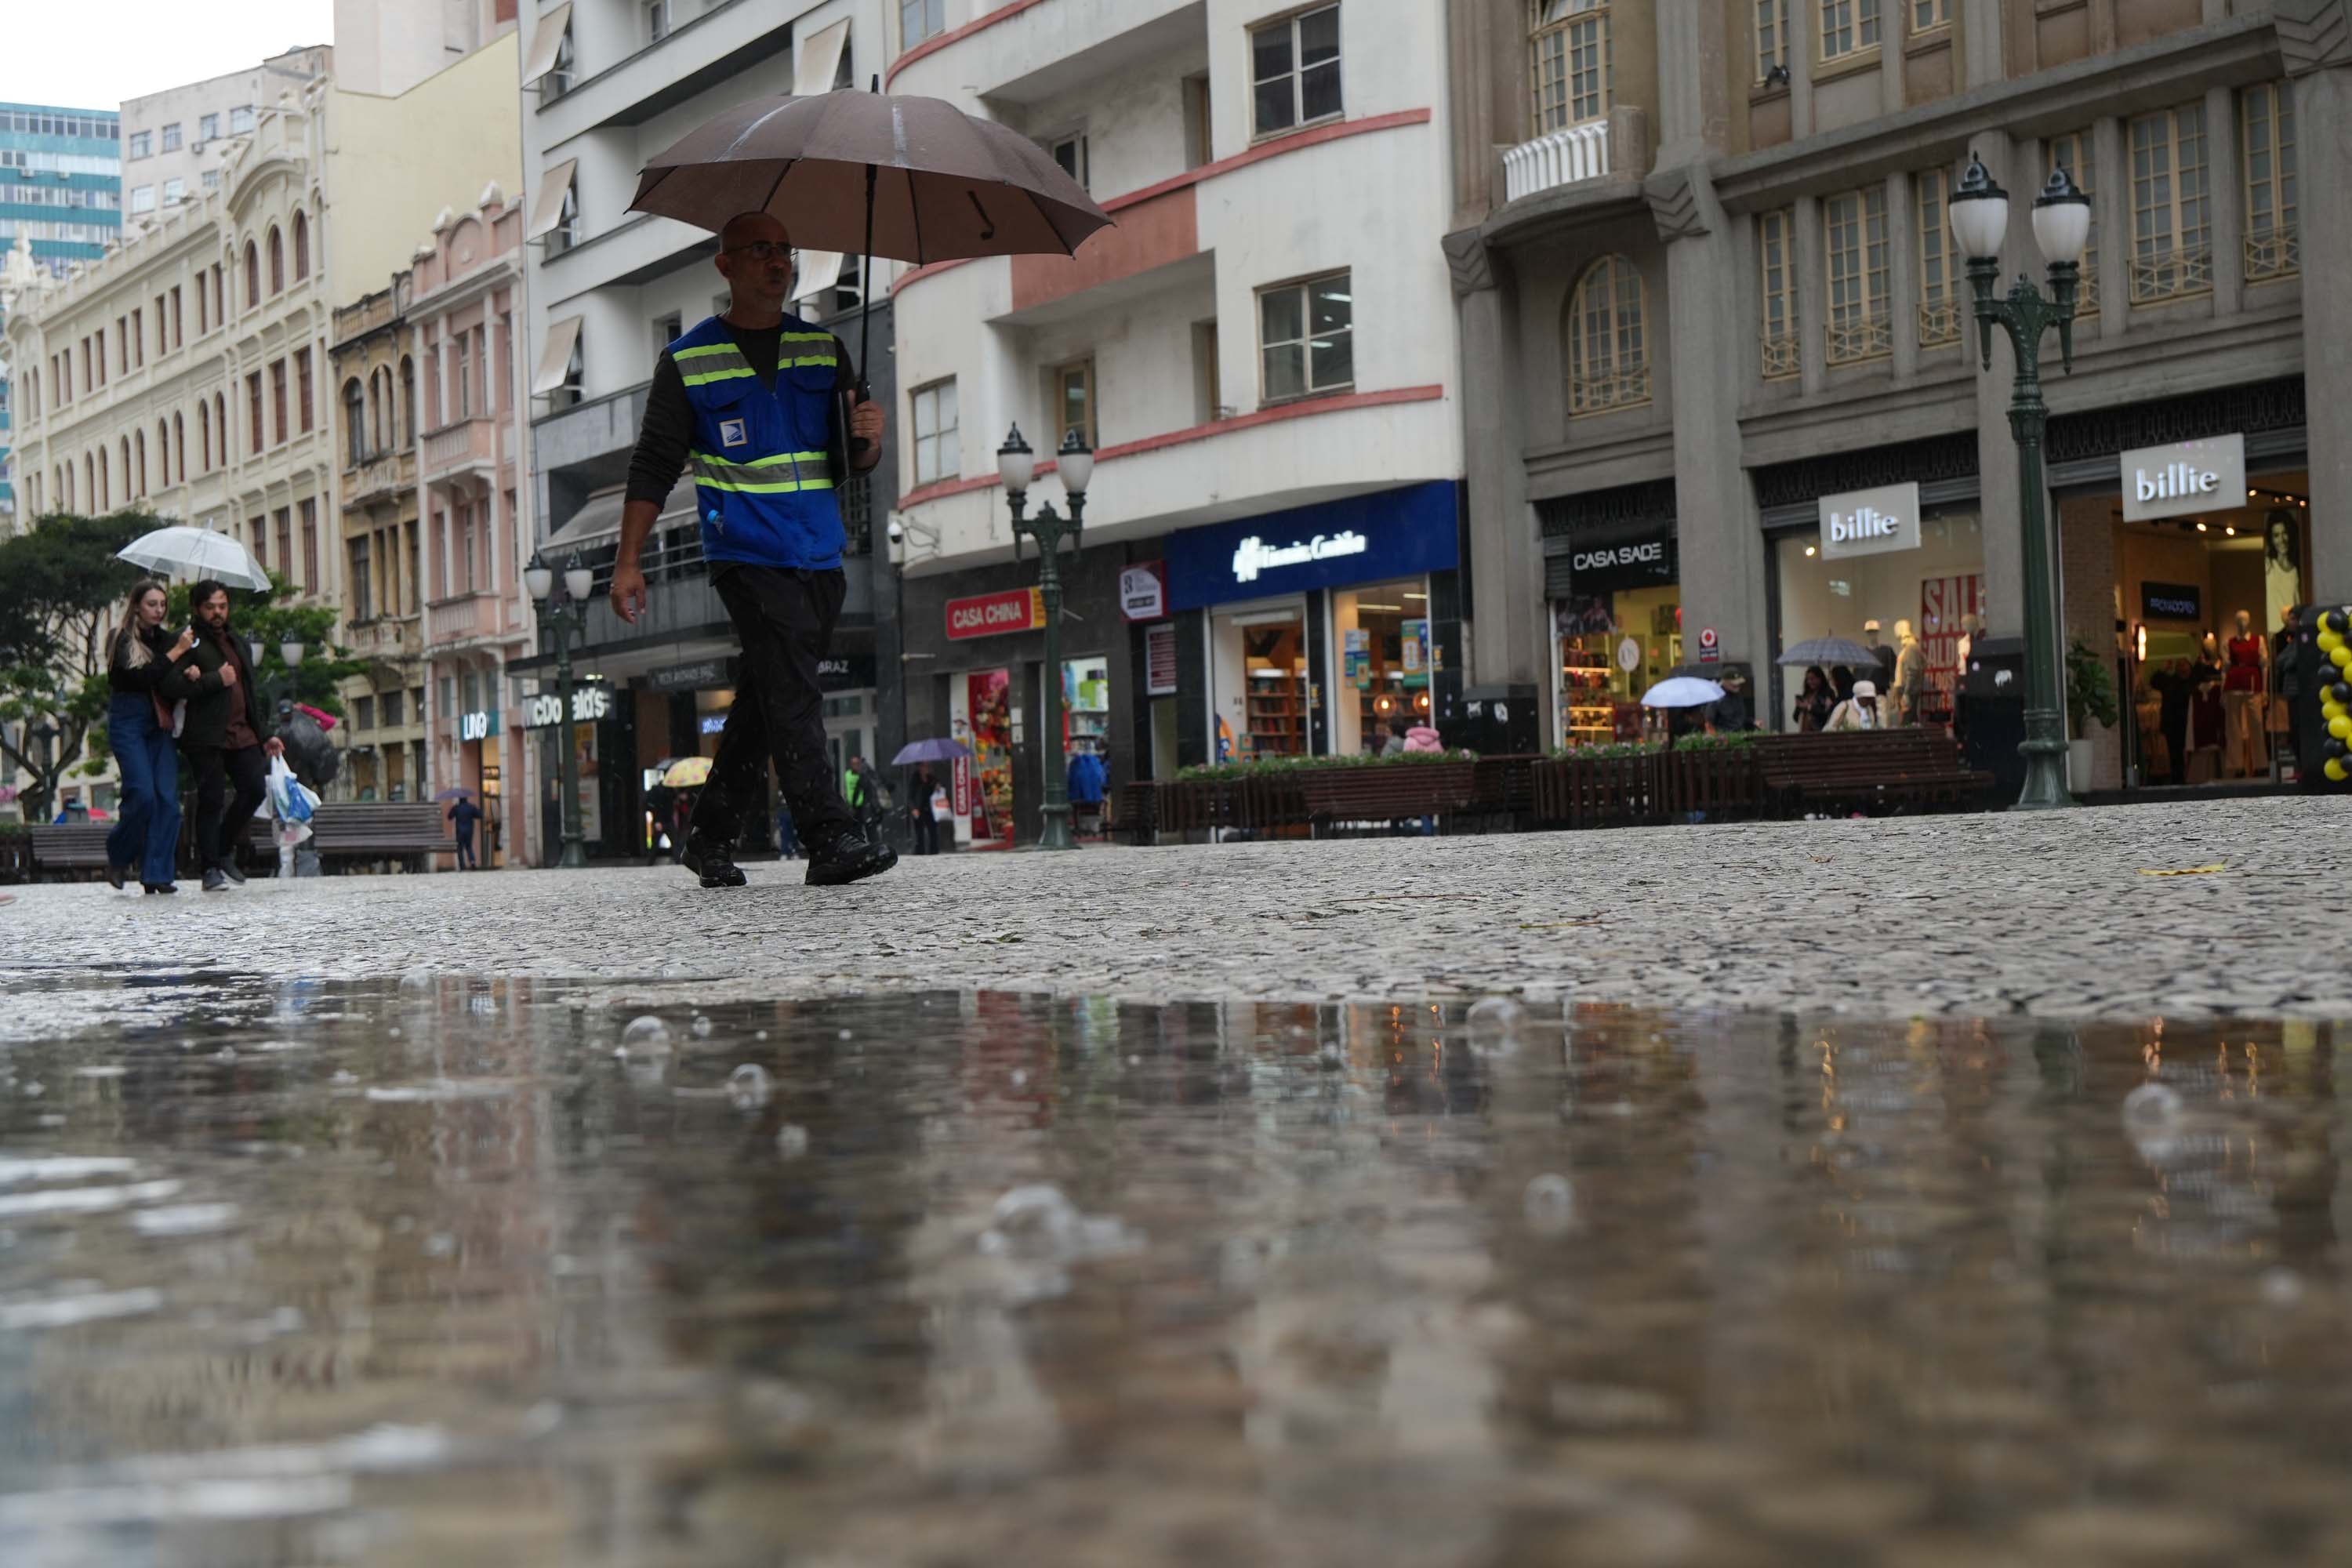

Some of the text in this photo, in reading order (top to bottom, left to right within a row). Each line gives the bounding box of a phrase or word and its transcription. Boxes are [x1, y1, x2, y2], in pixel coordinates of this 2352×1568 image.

[2136, 462, 2220, 502] billie
[1831, 507, 1898, 543] billie
[1573, 543, 1661, 571] CASA SADE
[953, 606, 985, 629] CASA
[985, 601, 1022, 624] CHINA
[521, 688, 607, 728] McDoald's
